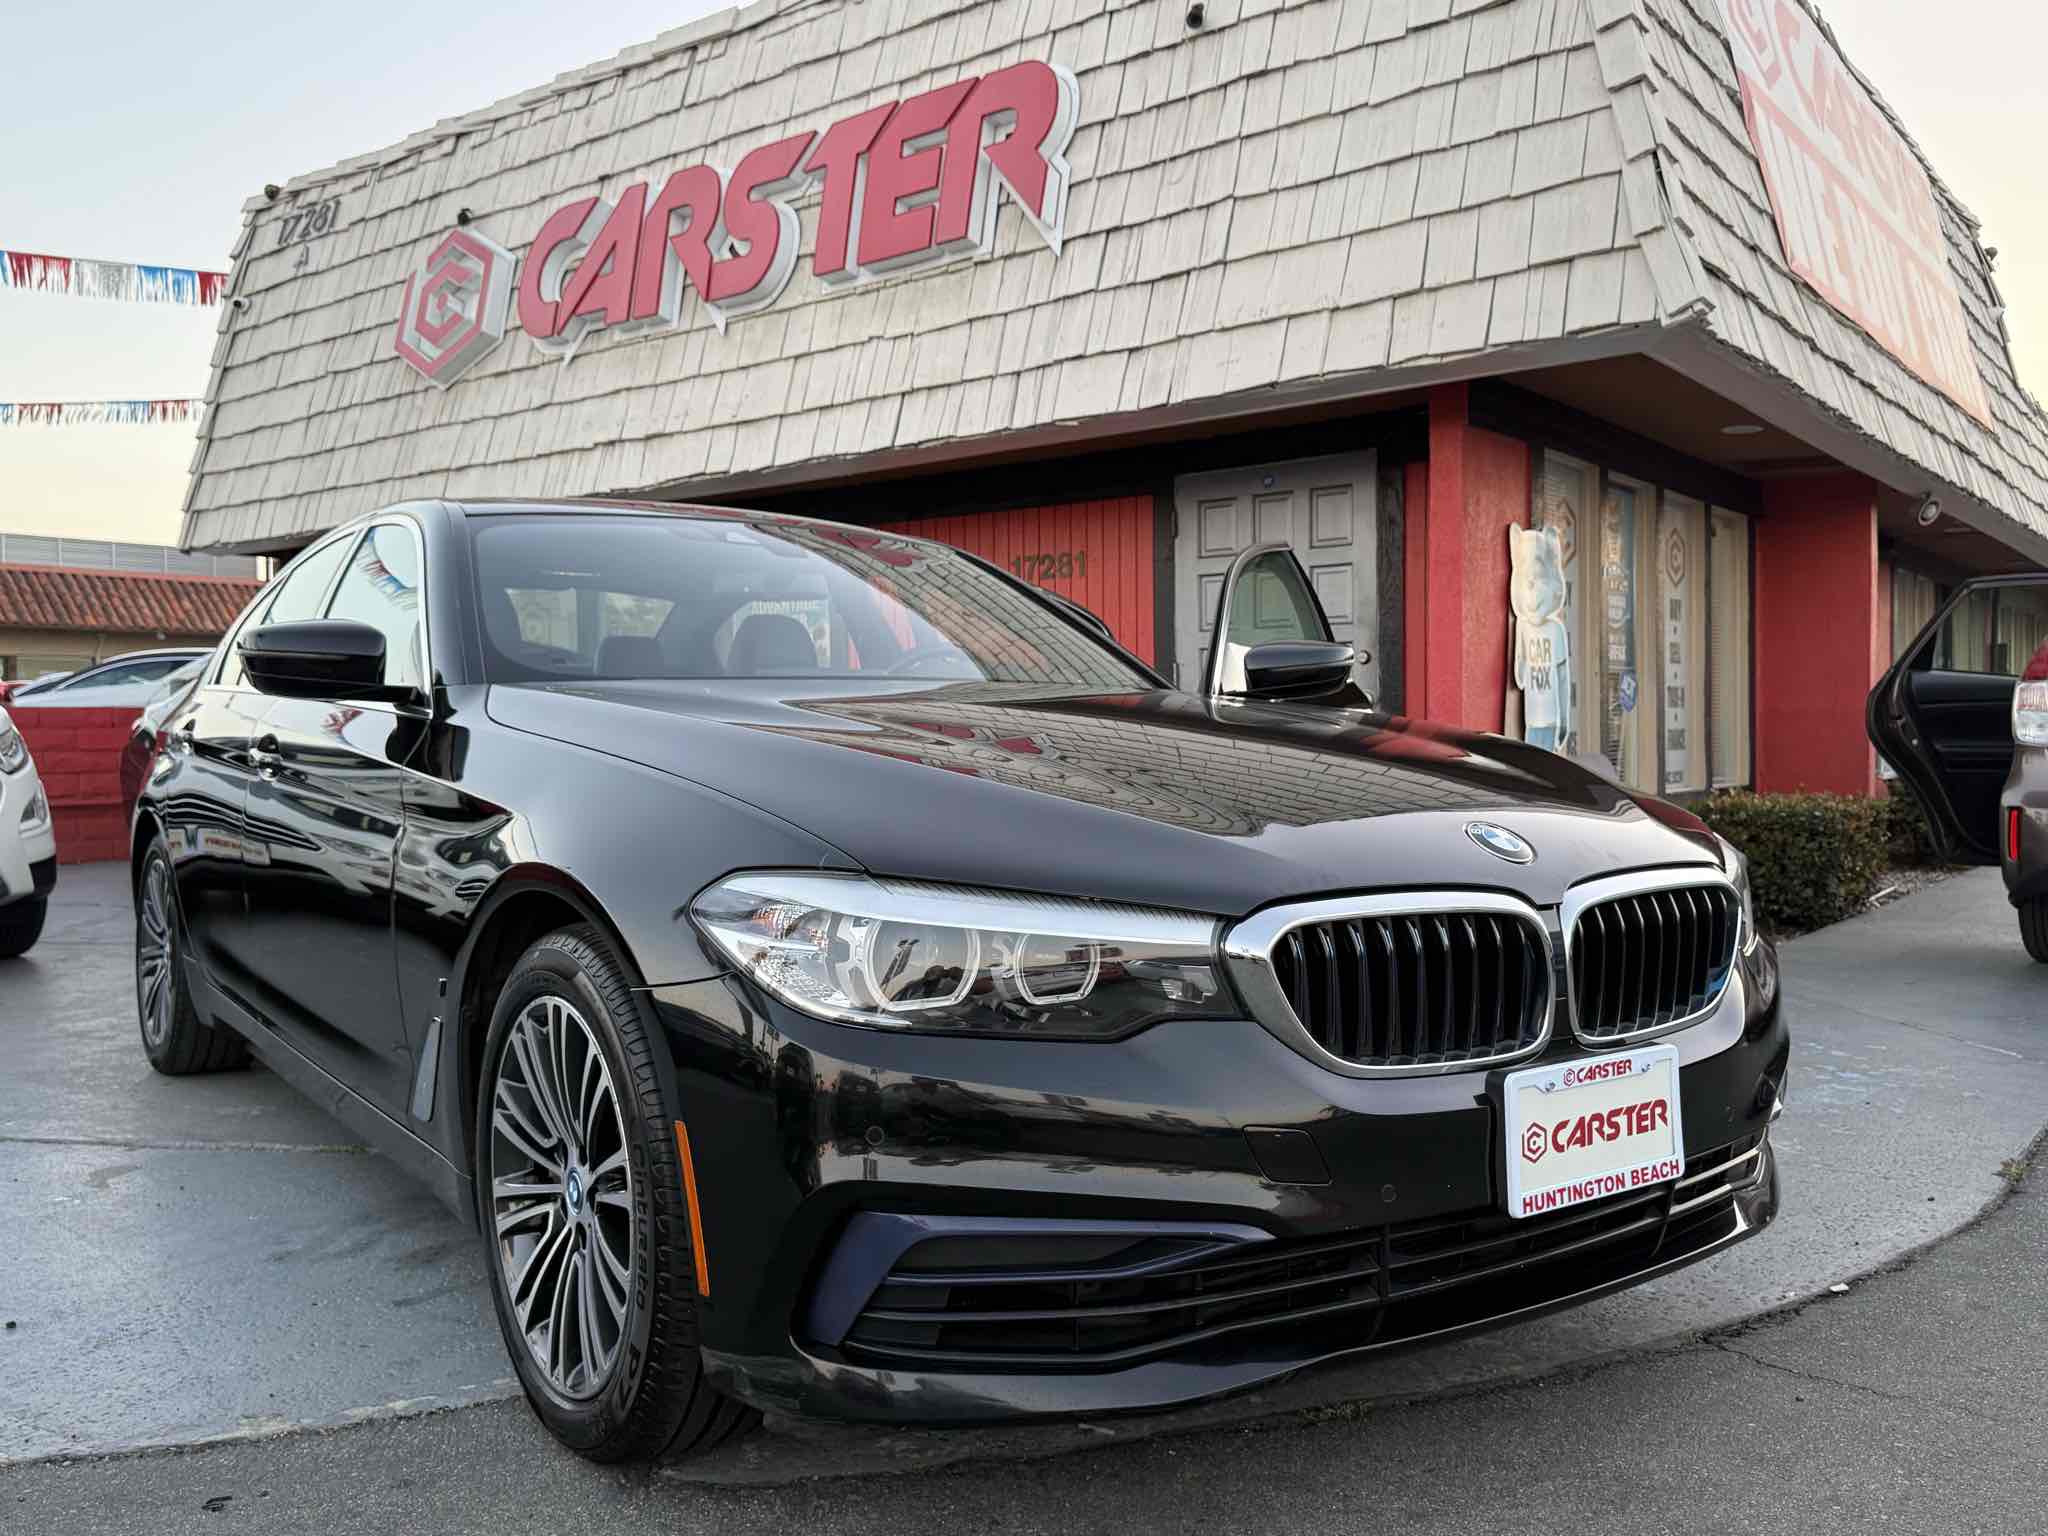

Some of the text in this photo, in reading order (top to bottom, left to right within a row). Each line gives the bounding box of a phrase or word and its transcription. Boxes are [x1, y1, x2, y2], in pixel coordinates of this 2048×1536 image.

[518, 60, 1068, 342] CARSTER
[278, 200, 341, 245] 17281
[1013, 551, 1086, 582] 17281
[1529, 638, 1552, 663] CAR
[1530, 666, 1552, 691] FOX
[1576, 1059, 1633, 1083] CARSTER
[1551, 1099, 1668, 1153] CARSTER
[1523, 1159, 1680, 1214] HUNTINGTON BEACH
